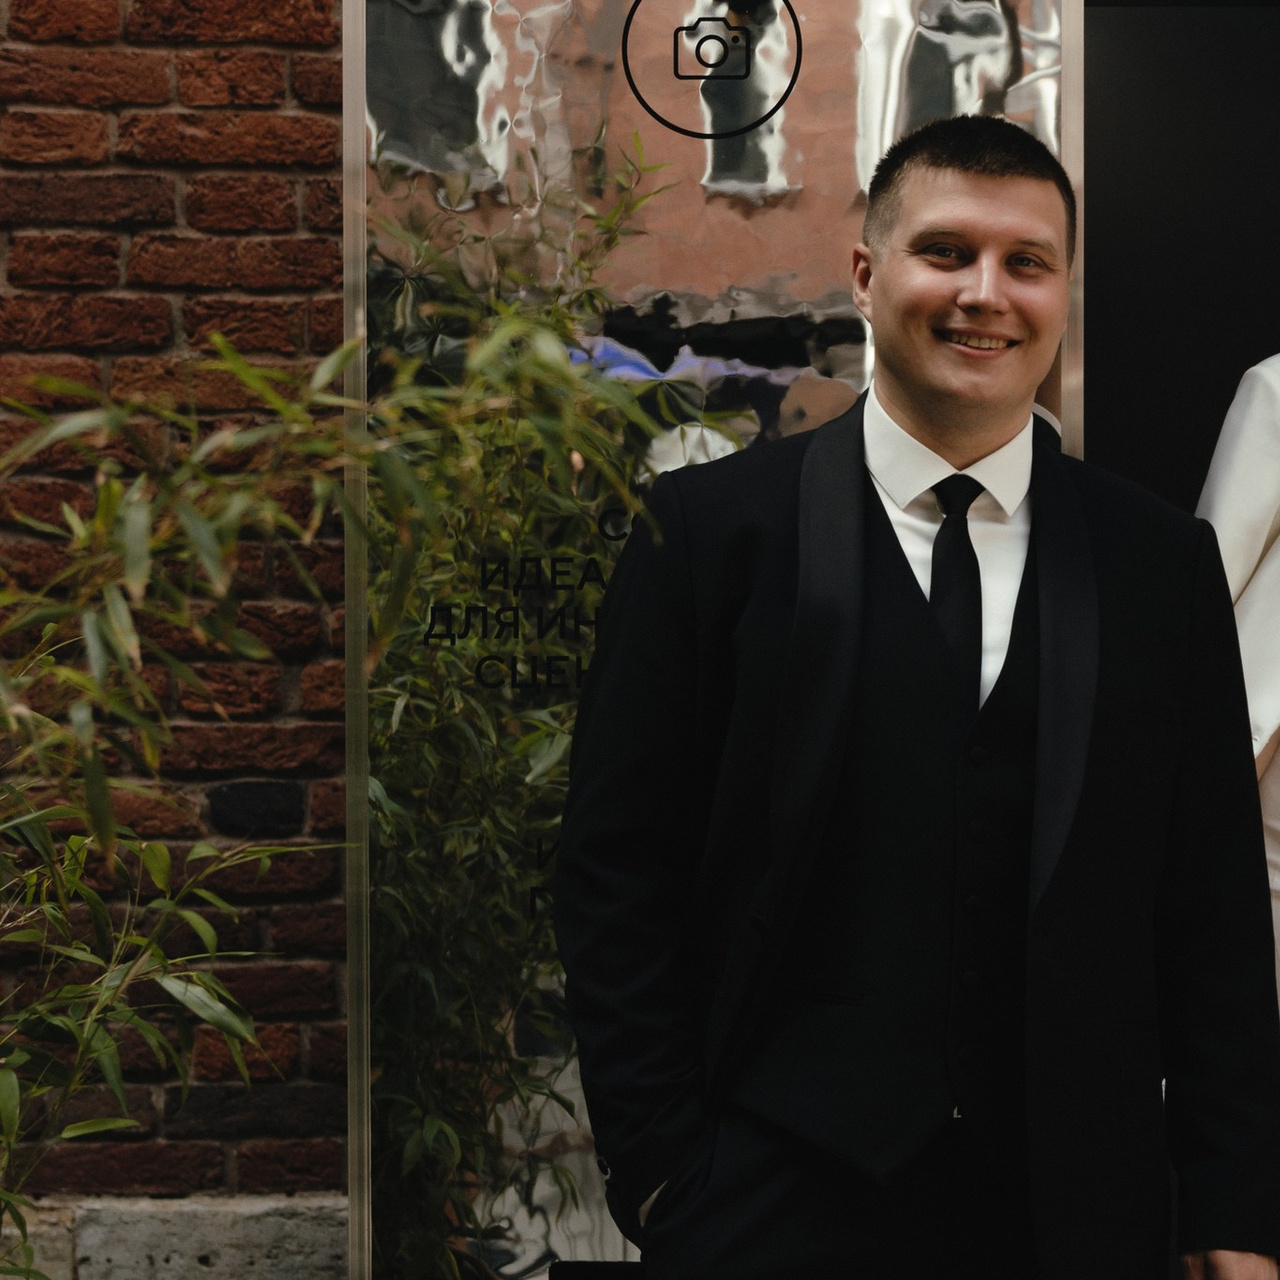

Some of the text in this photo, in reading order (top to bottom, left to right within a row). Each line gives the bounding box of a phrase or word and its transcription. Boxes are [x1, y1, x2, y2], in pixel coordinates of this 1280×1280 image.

[480, 557, 606, 596] ИДЕА
[424, 606, 601, 645] ДЛЯ ИН
